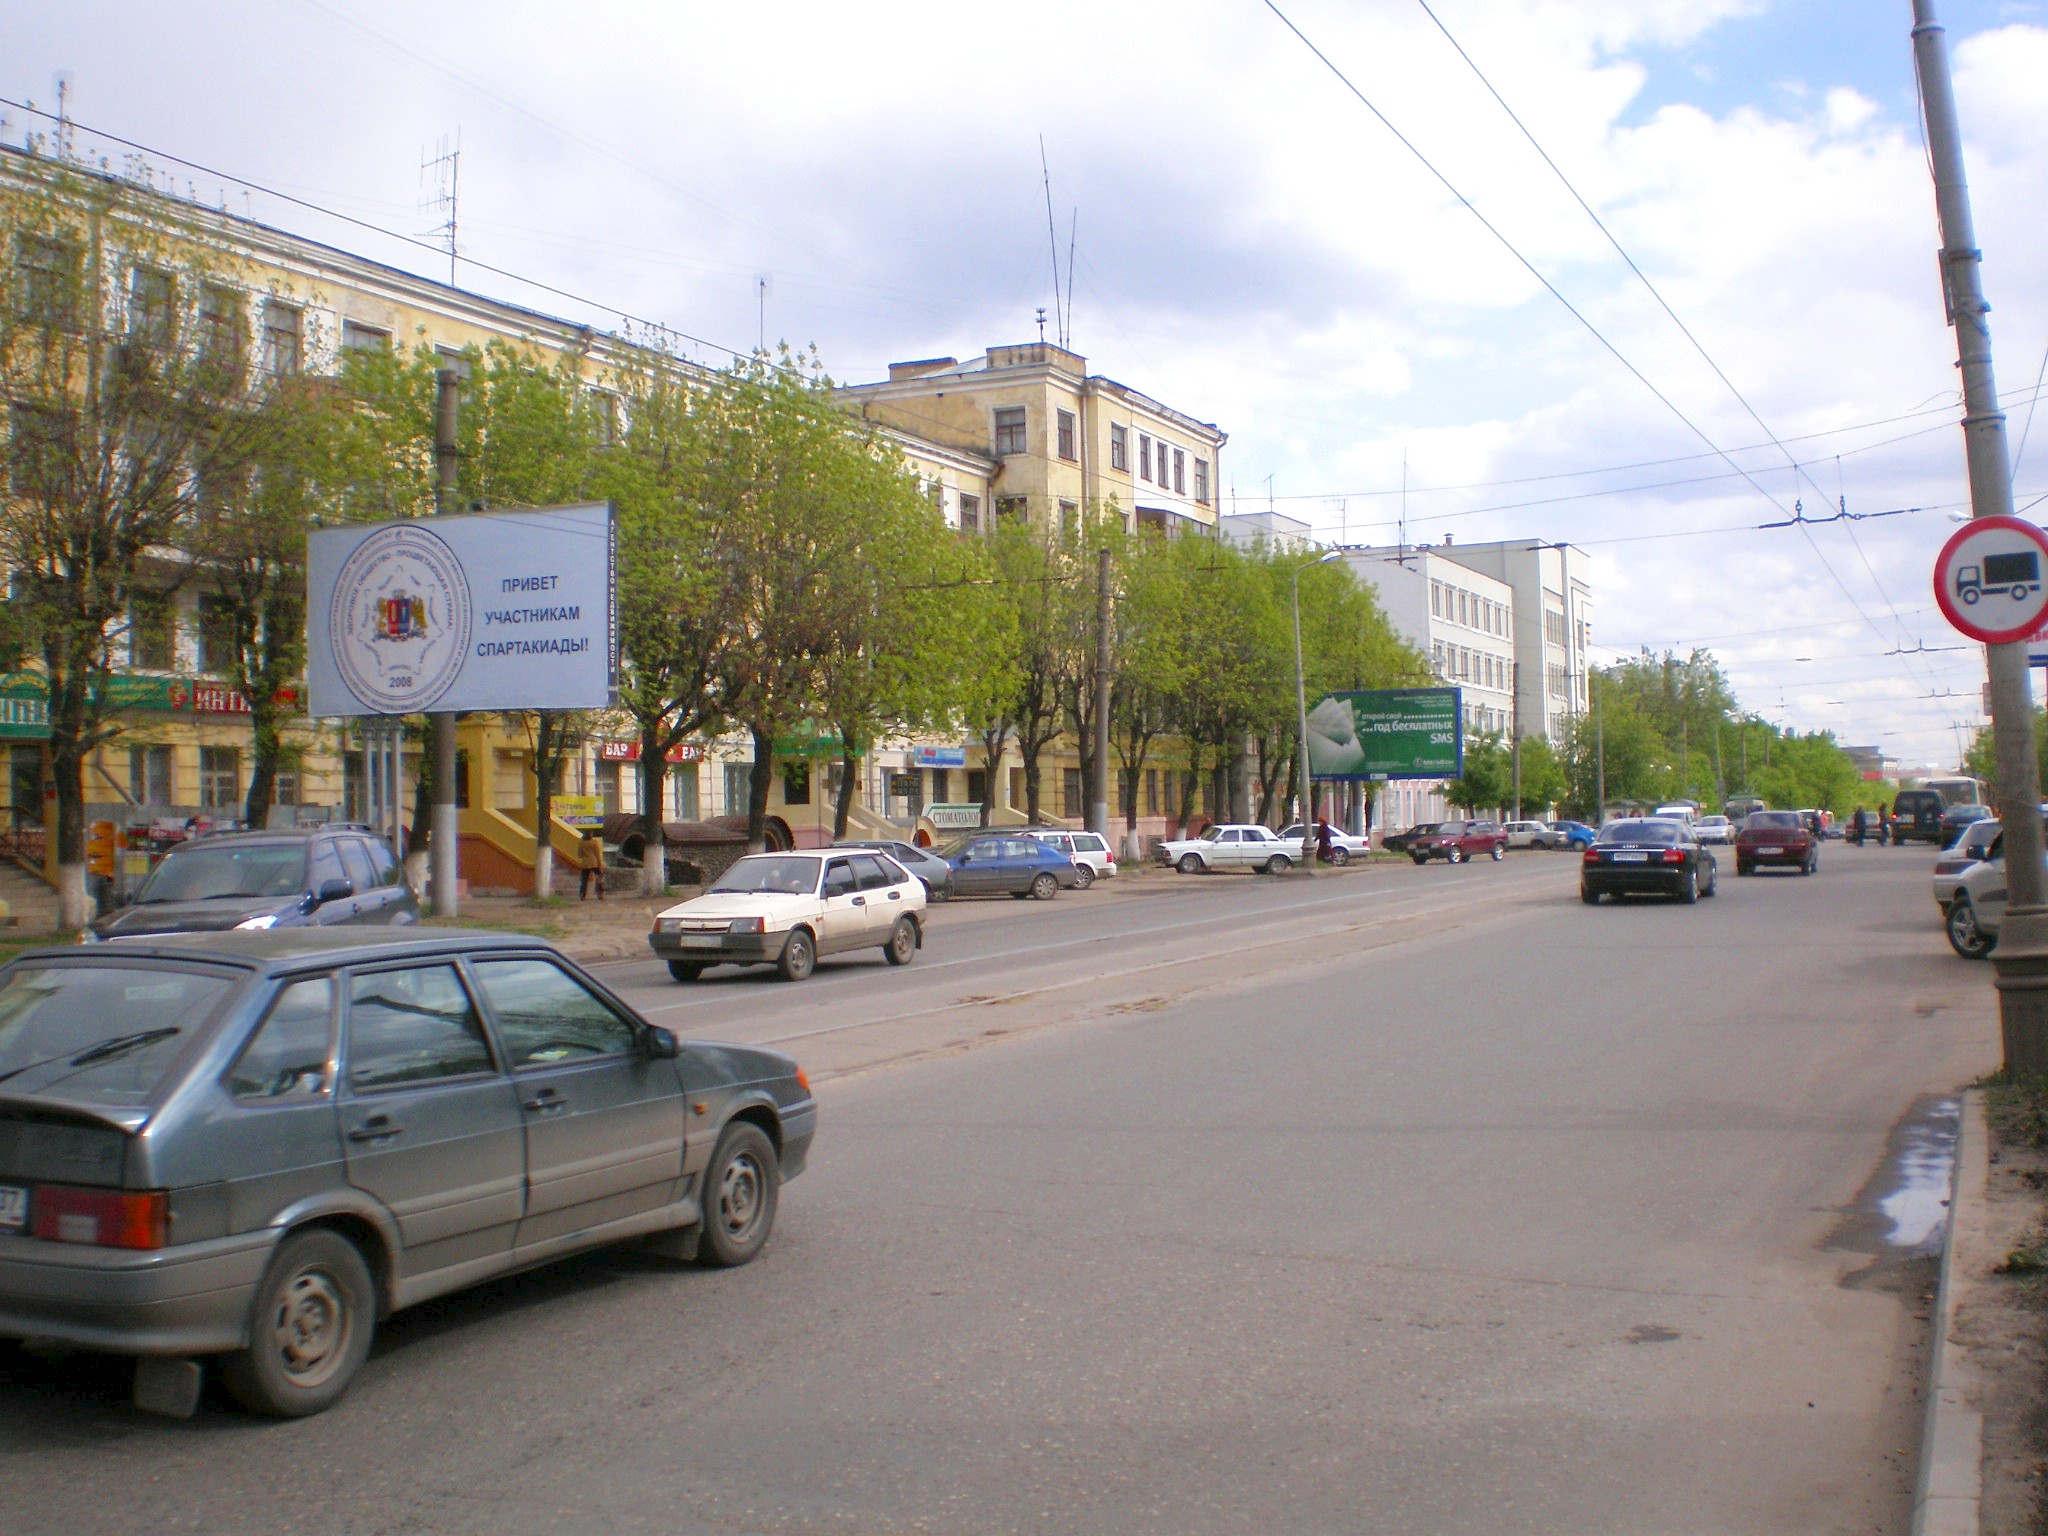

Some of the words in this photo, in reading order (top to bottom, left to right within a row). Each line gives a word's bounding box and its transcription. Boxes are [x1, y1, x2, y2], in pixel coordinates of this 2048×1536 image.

[502, 575, 558, 593] ПРИВЕТ
[346, 585, 360, 636] ЗДОРОВОЕ
[355, 549, 391, 587] ОБЩЕСТВО
[485, 606, 580, 625] УЧАСТНИКАМ
[477, 637, 589, 657] СПАРТАКИАДЫ!
[389, 676, 413, 688] 2008
[1361, 712, 1386, 720] открой
[1391, 720, 1453, 732] бесплатных
[1430, 732, 1454, 744] SMS
[932, 812, 981, 824] СТОМАТОЛОГ
